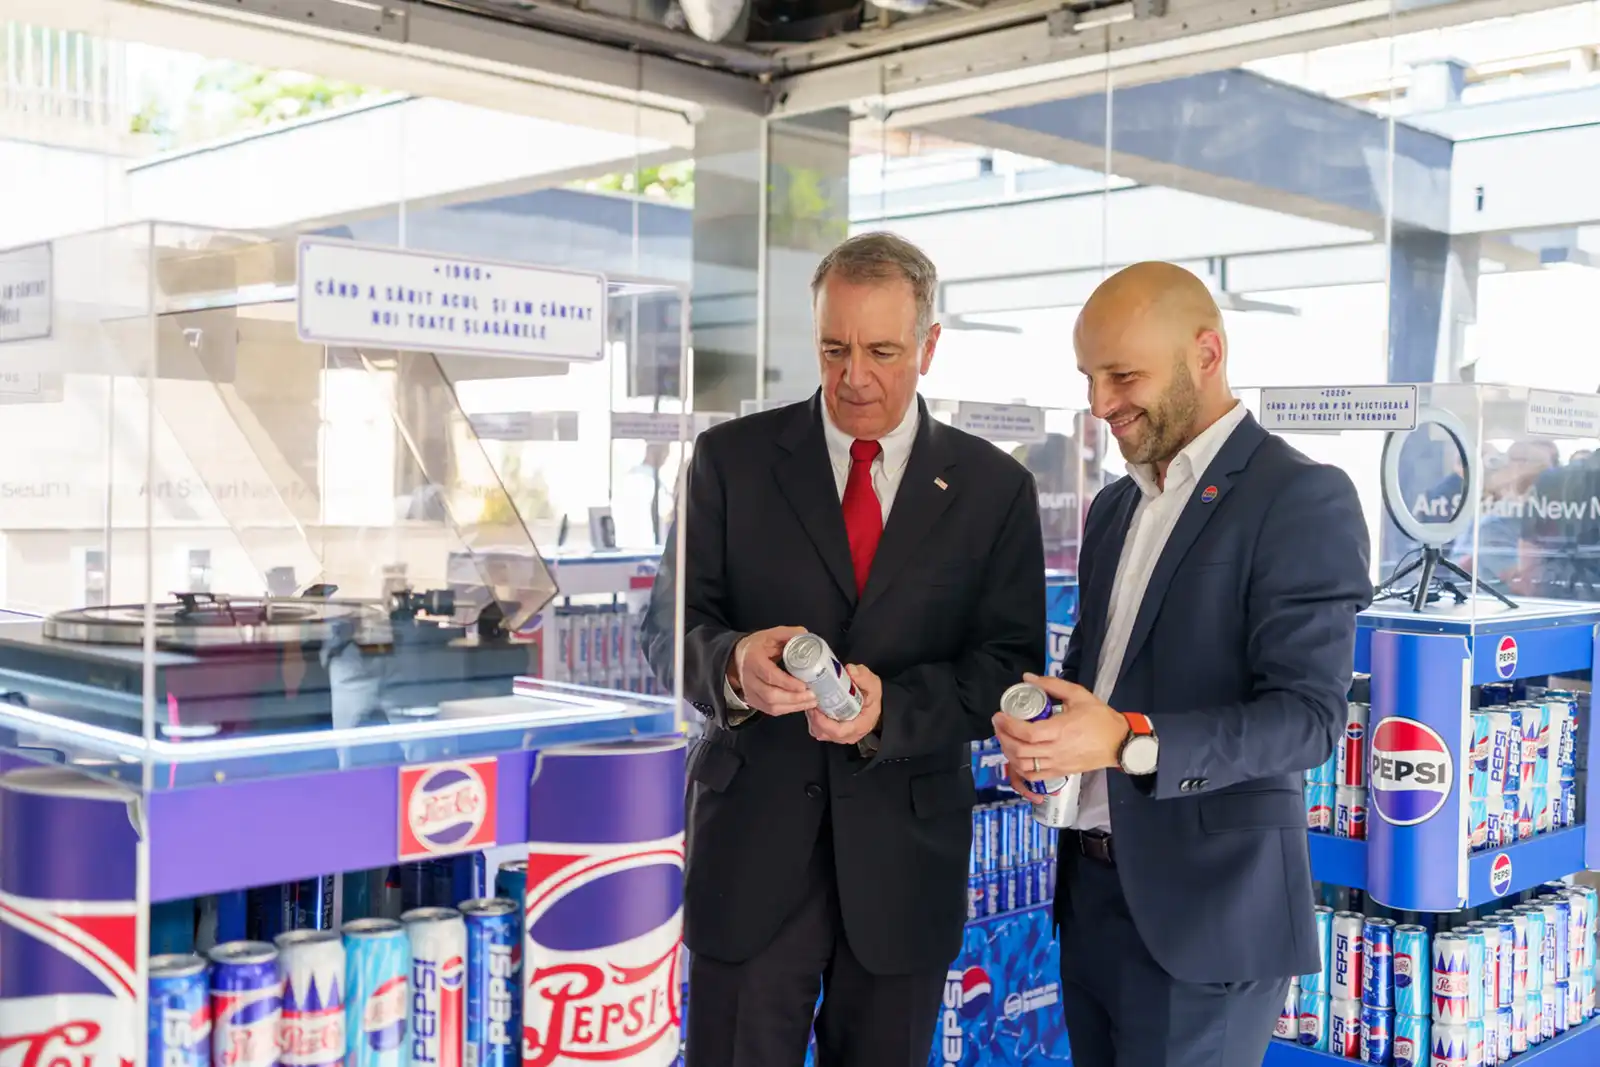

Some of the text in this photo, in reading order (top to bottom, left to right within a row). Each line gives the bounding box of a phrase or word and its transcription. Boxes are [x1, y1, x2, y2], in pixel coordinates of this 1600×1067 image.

[367, 285, 377, 301] A
[442, 293, 480, 311] ACUL
[514, 300, 534, 316] AM
[371, 310, 399, 326] NOI
[407, 313, 455, 332] TOATE
[1289, 402, 1298, 411] AI
[1300, 402, 1317, 411] PUS
[1341, 402, 1352, 410] DE
[1325, 389, 1347, 397] 2020
[1313, 413, 1341, 421] TREZIT
[1356, 413, 1398, 421] TRENDING
[1411, 493, 1449, 517] Art
[1528, 495, 1587, 519] New
[1499, 652, 1517, 662] PEPSI
[1490, 730, 1507, 782] PEPSI
[1508, 725, 1521, 777] PEPSI
[1372, 754, 1446, 785] PEPSI
[1493, 868, 1510, 881] PEPSI
[1336, 933, 1349, 987] PEPSI
[1363, 938, 1374, 992] PEPSI
[488, 943, 512, 1045] PEPSI
[412, 957, 437, 1064] PEPSI
[942, 969, 964, 1067] EPSI
[1333, 1015, 1346, 1055] EPSI
